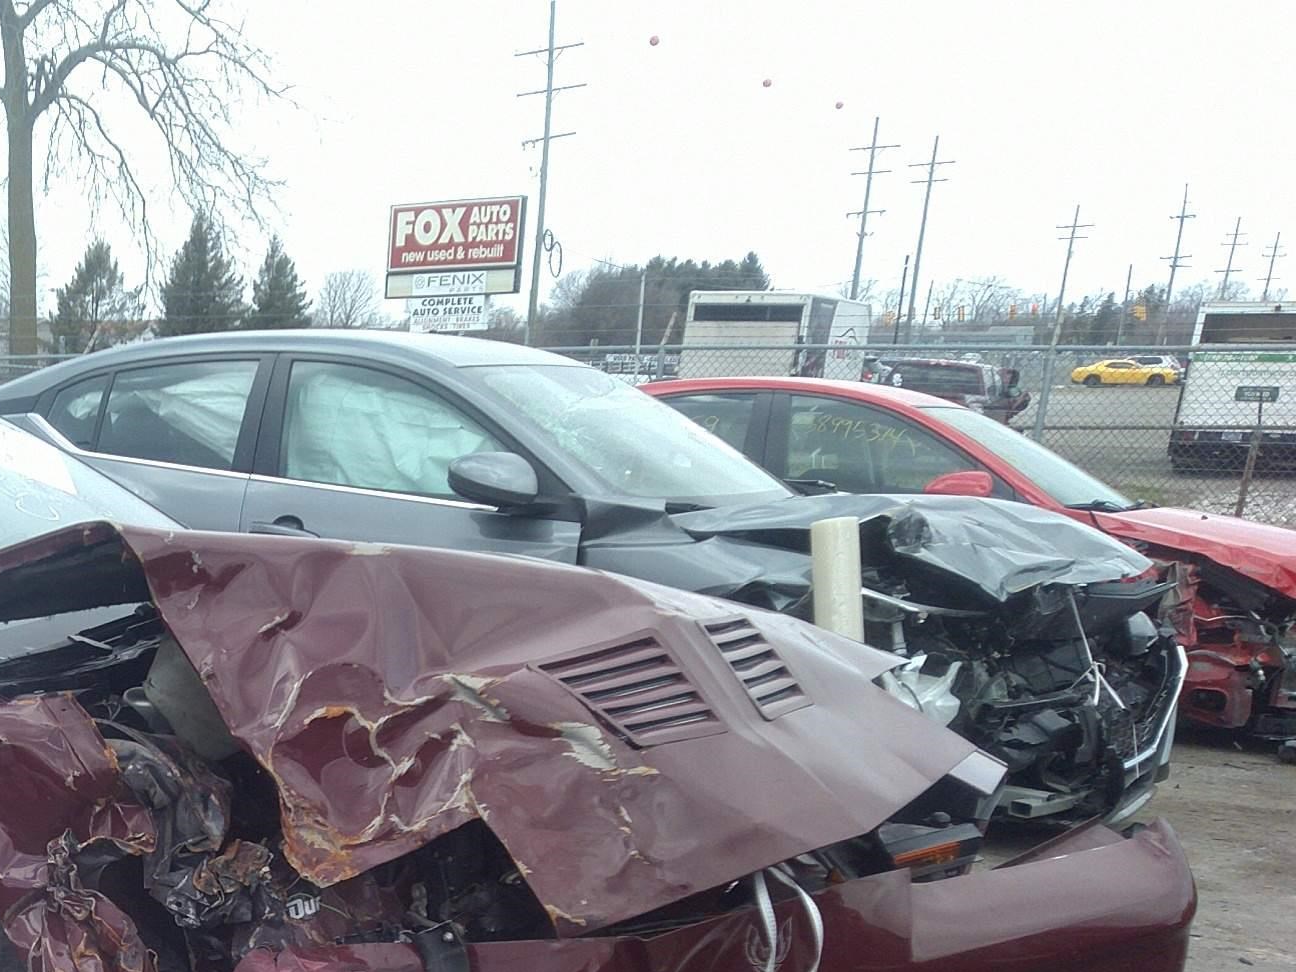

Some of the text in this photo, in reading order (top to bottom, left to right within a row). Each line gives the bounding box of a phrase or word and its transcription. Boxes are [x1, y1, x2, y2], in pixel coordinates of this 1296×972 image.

[469, 205, 511, 223] AUTO
[396, 208, 466, 246] FOX
[468, 223, 513, 241] PARTS
[401, 244, 504, 263] new used & rebuilt
[427, 273, 484, 287] FENIX
[413, 306, 482, 316] AUTO SERVICE
[422, 298, 473, 306] COMPLETE
